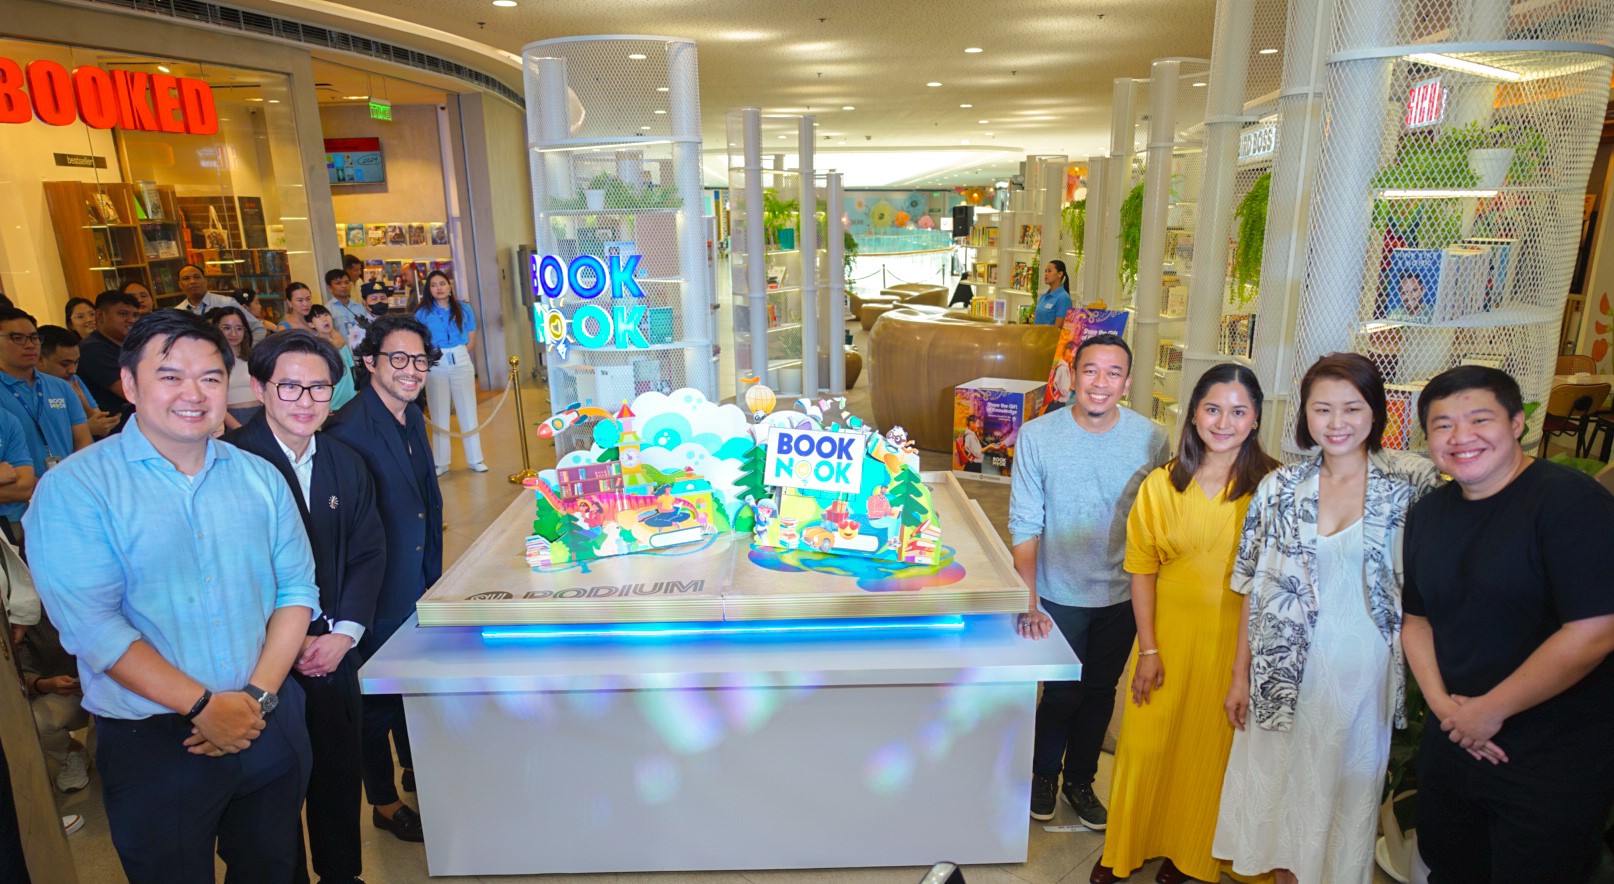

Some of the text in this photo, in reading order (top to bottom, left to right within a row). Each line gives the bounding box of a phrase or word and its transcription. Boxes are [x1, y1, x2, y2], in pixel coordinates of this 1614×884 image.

[0, 57, 219, 135] BOOKED
[530, 254, 646, 299] BOOK
[777, 432, 855, 461] BOOK
[522, 580, 705, 599] PODIUM
